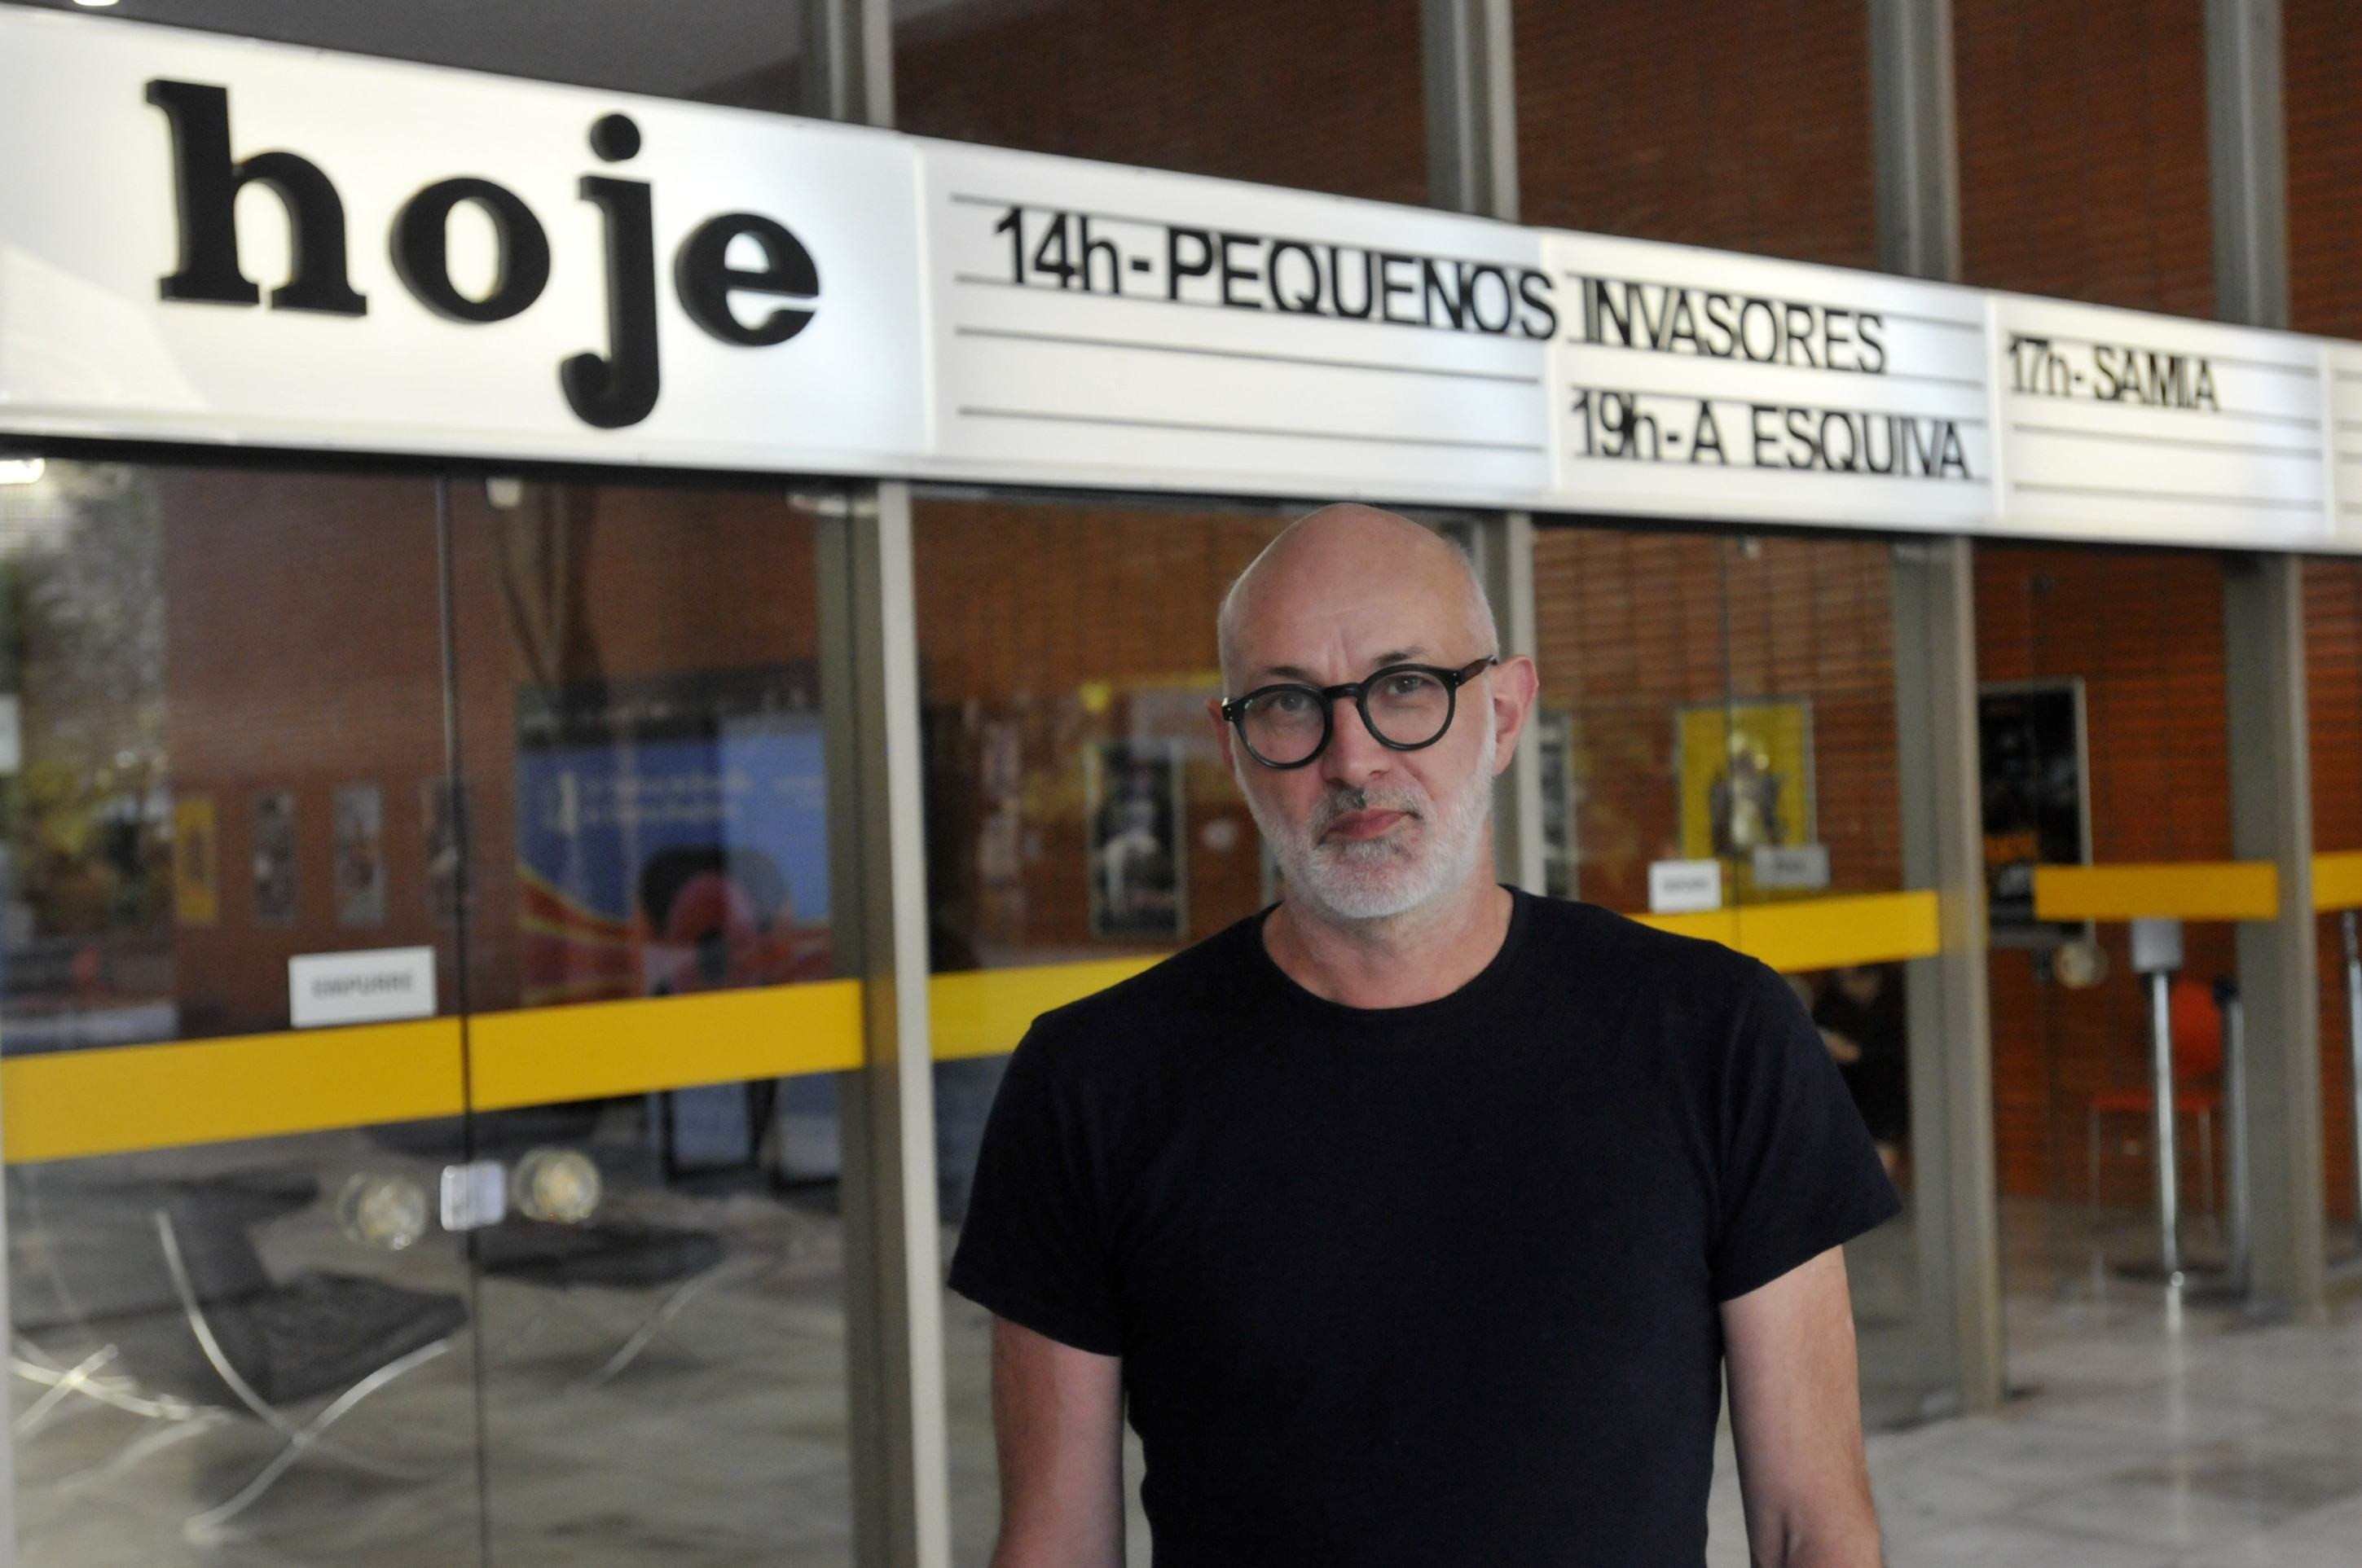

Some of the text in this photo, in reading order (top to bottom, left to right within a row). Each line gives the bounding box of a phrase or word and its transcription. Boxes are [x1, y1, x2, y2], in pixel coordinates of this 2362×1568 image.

[145, 77, 820, 428] hoje
[1580, 277, 1886, 375] INVASORES
[1752, 404, 1973, 479] ESQUIVA
